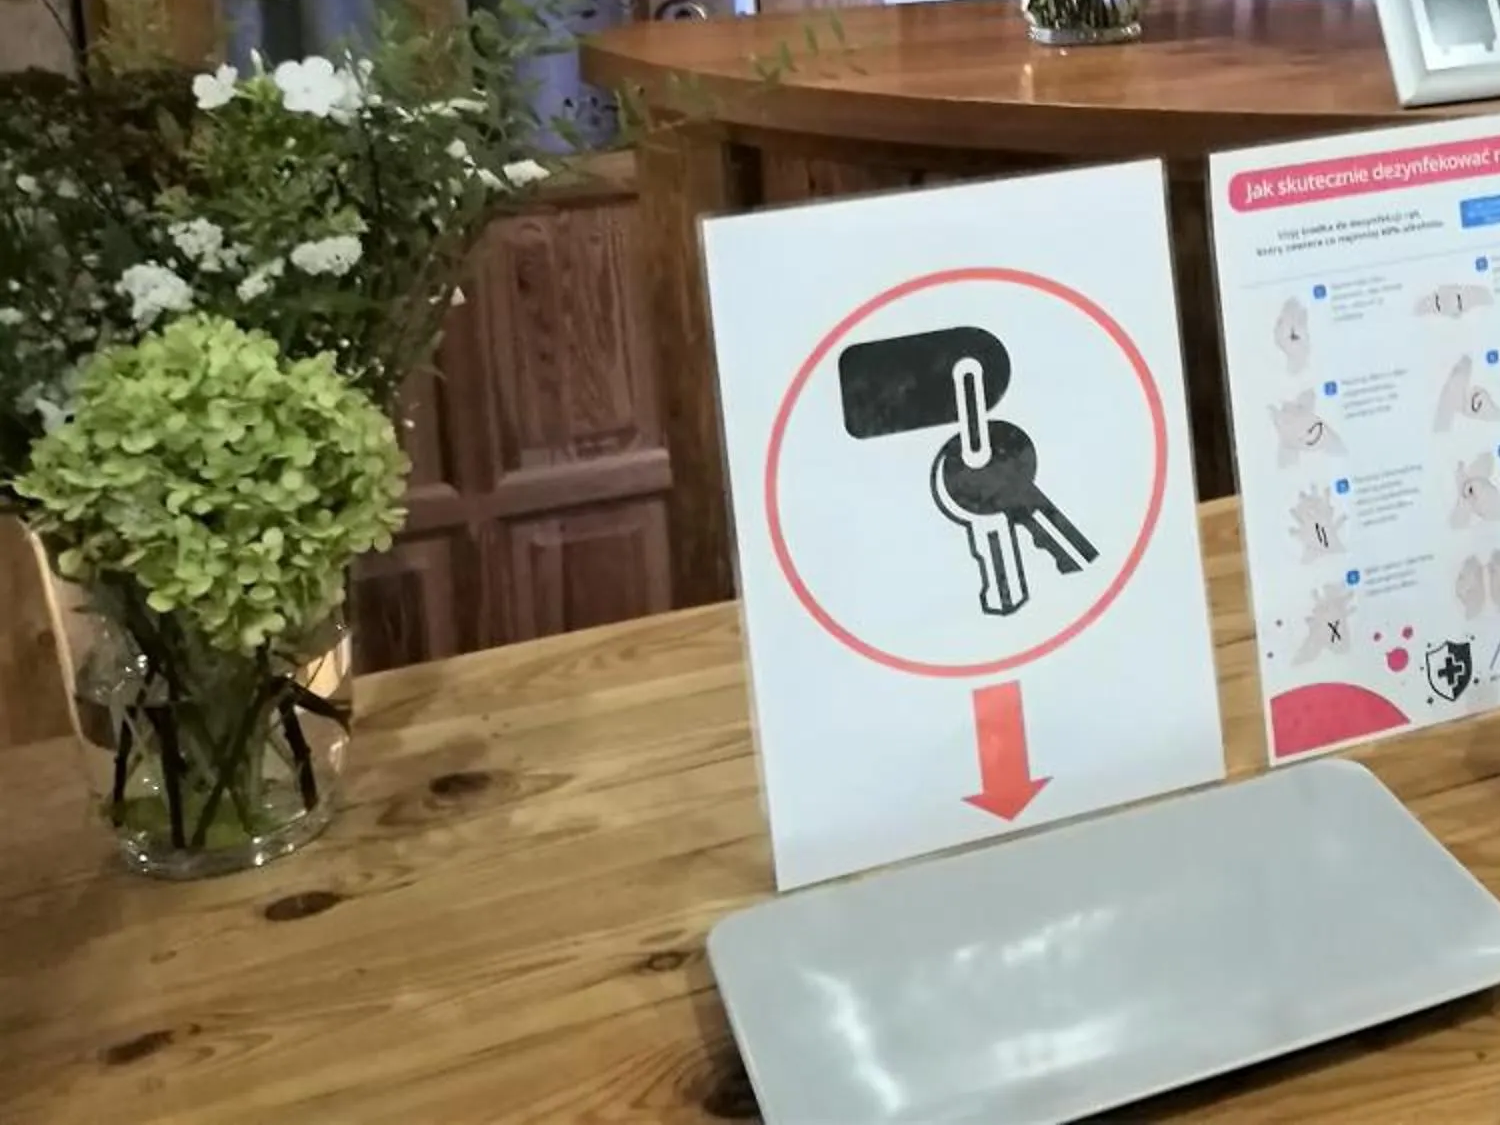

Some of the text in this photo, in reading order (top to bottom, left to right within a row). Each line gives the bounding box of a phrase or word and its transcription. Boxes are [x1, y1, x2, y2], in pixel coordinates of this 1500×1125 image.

[1245, 179, 1274, 203] Jak
[1277, 166, 1369, 196] skutecznie
[1372, 147, 1491, 181] dezynfekować
